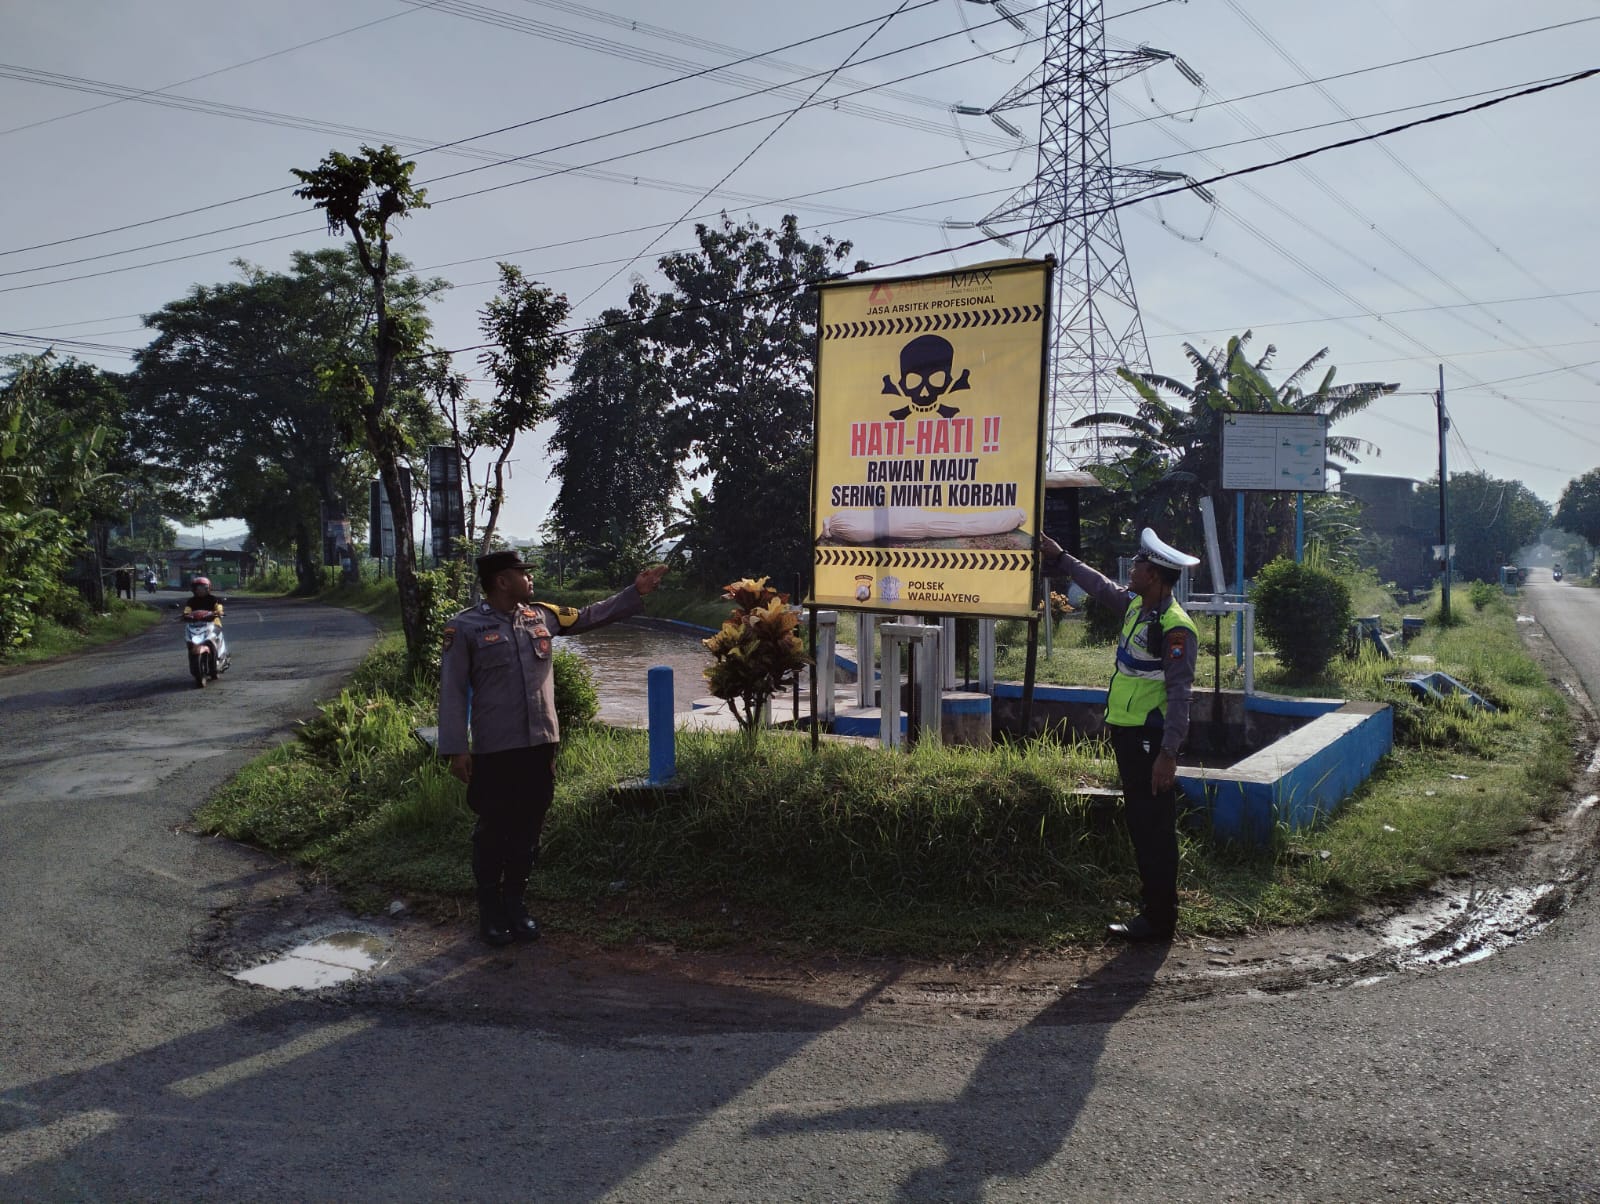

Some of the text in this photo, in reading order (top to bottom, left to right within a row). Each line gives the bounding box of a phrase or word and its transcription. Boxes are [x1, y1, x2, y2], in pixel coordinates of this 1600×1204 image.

[867, 296, 995, 316] JASA ARSITEK PROFESIONAL
[851, 416, 1001, 457] HATI-HATI !!
[867, 458, 979, 482] RAWAN MAUT
[831, 483, 1017, 507] SERING MINTA KORBAN
[908, 580, 945, 590] POLSEK
[908, 592, 980, 603] WARUJAYENG
